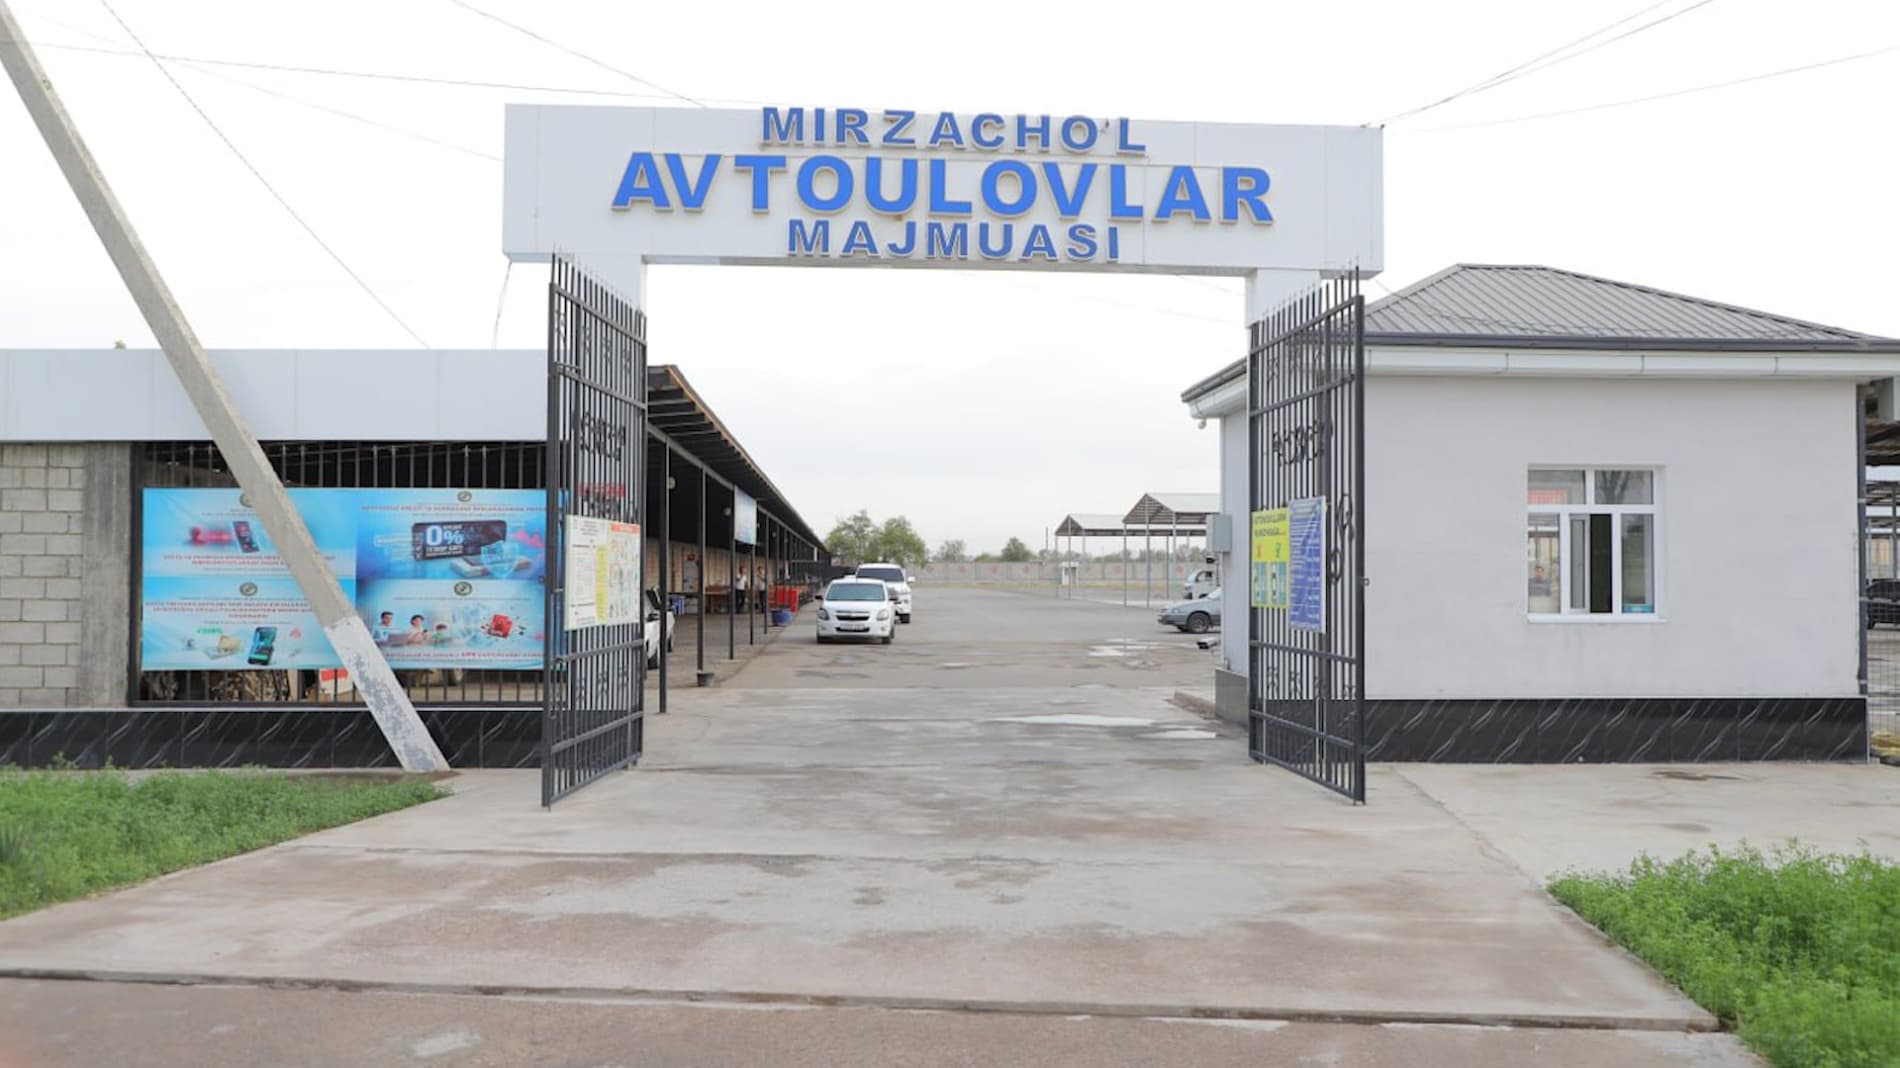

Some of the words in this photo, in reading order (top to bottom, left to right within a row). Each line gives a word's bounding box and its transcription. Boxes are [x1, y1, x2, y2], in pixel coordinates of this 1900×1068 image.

[762, 106, 1146, 151] MIRZACHO'L
[612, 152, 1274, 223] AVTOULOVLAR
[788, 219, 1119, 260] MAJMUASI
[426, 525, 465, 546] 0%
